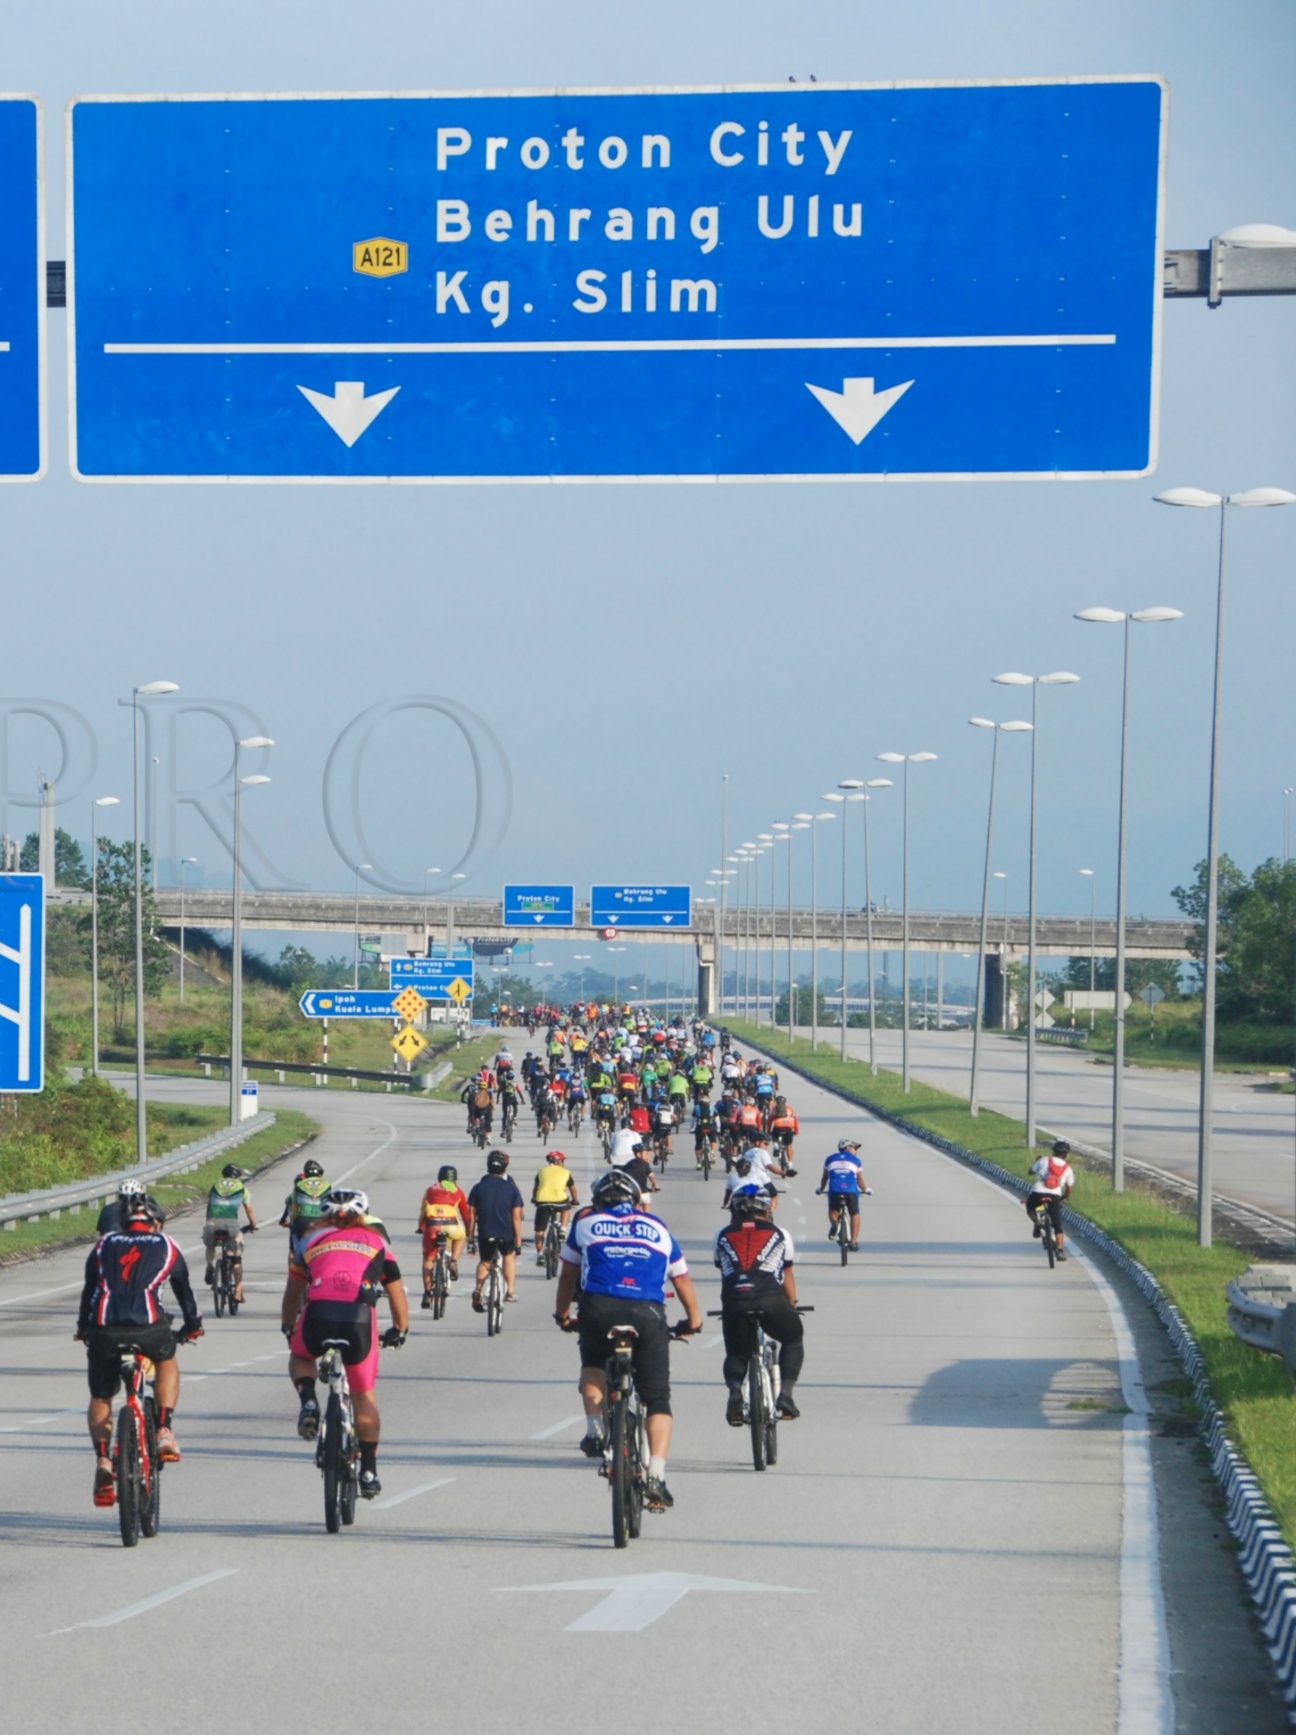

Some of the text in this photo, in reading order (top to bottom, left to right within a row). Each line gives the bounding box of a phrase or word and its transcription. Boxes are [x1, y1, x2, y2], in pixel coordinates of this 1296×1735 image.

[436, 121, 853, 175] Proton City
[435, 195, 862, 254] Behrang Ulu
[360, 246, 402, 268] A121
[435, 269, 717, 328] Kg. Slim
[516, 894, 560, 903] Proton City
[623, 888, 653, 897] Behrang
[413, 960, 443, 968] Behrang
[335, 995, 356, 1004] Ipoh
[334, 1005, 396, 1015] Kuala Lumpu
[594, 1222, 659, 1242] QUICK STEP
